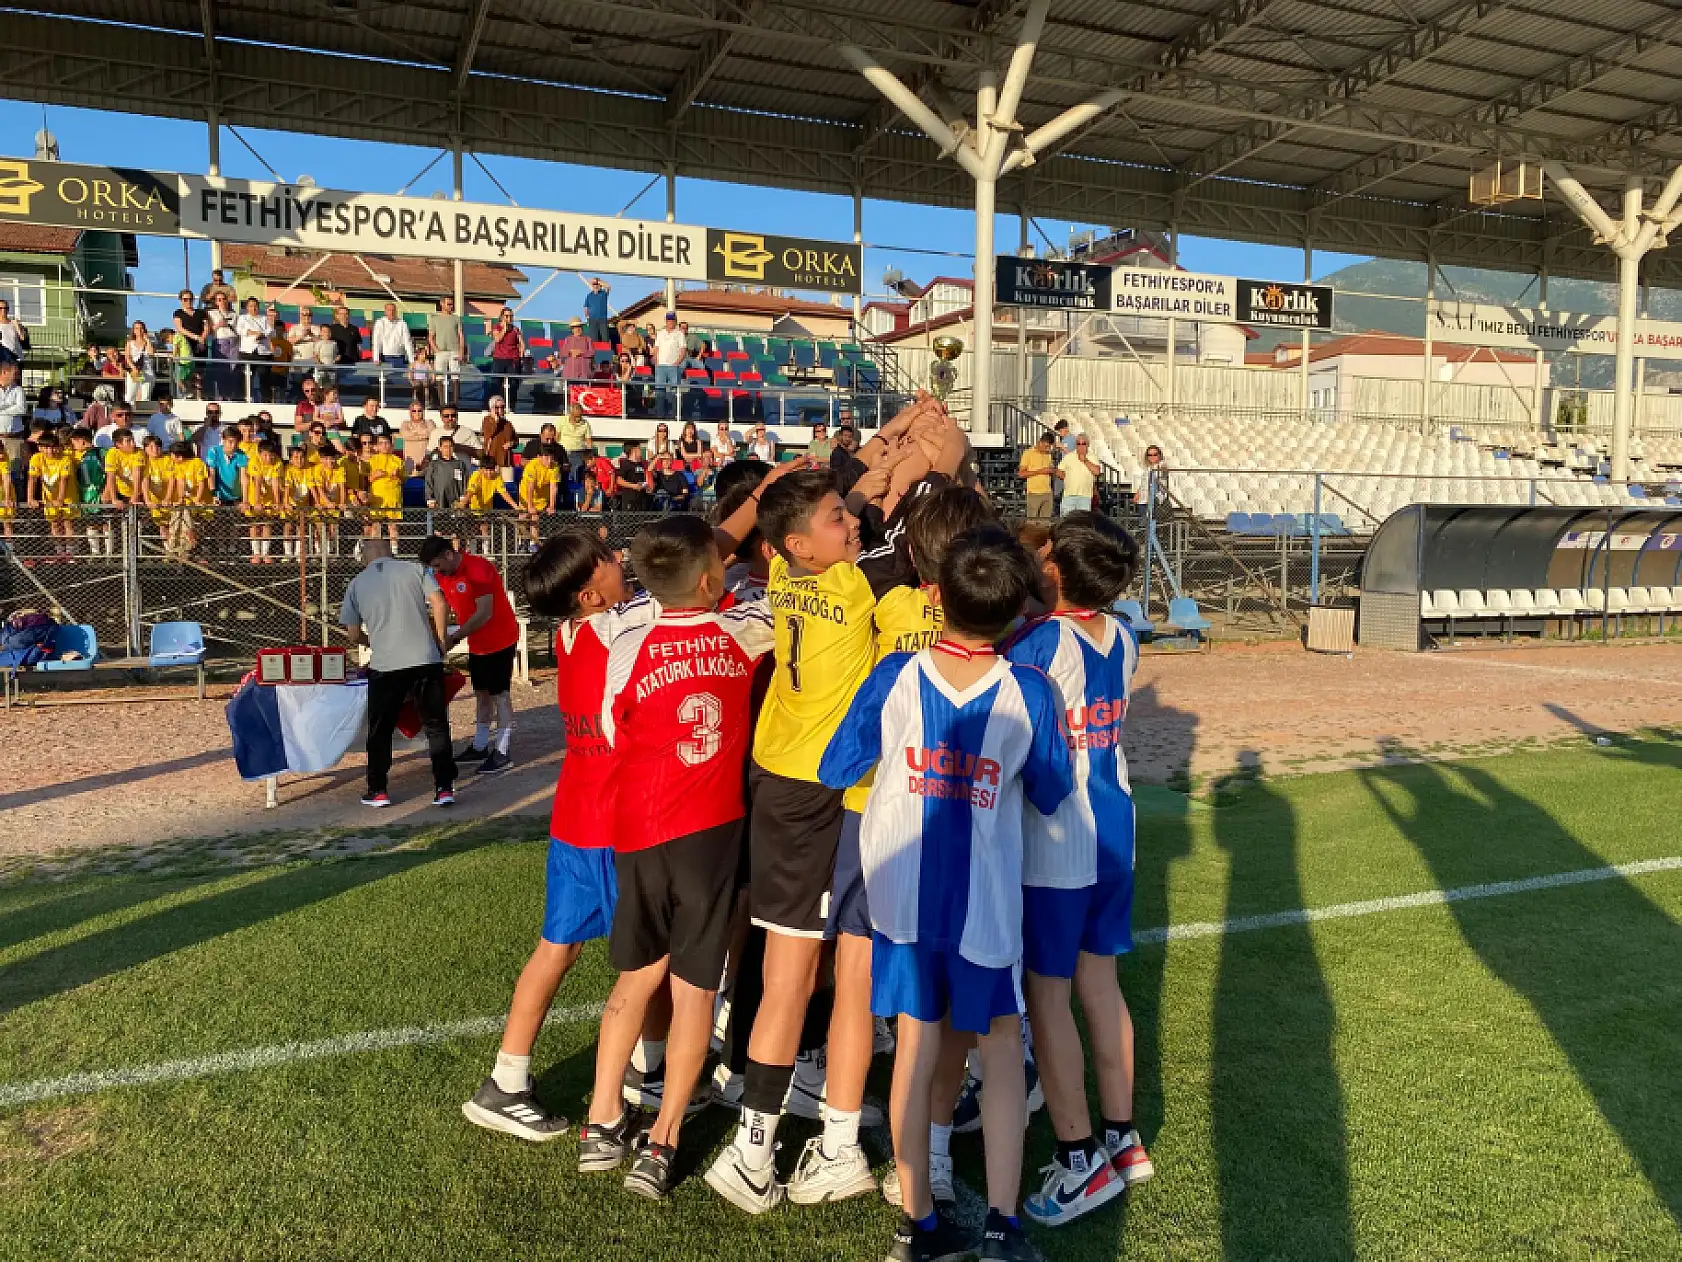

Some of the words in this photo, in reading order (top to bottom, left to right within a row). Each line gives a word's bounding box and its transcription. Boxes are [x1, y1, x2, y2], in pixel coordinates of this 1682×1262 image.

[57, 177, 170, 213] ORKA
[76, 208, 155, 225] HOTELS
[201, 187, 447, 242] FETHİYESPOR'A
[455, 211, 609, 257] BAŞARILAR
[617, 222, 691, 266] DİLER
[781, 247, 857, 277] ORKA
[794, 273, 846, 288] HOTELS
[1123, 272, 1225, 295] FETHİYESPOR'A
[1116, 293, 1190, 313] BAŞARILAR
[1194, 297, 1231, 317] DİLER
[648, 634, 730, 660] FETHİYE
[785, 614, 804, 693] 1
[636, 659, 695, 704] ATATÜRK
[676, 691, 722, 768] 3
[905, 741, 1001, 787] UĞUR
